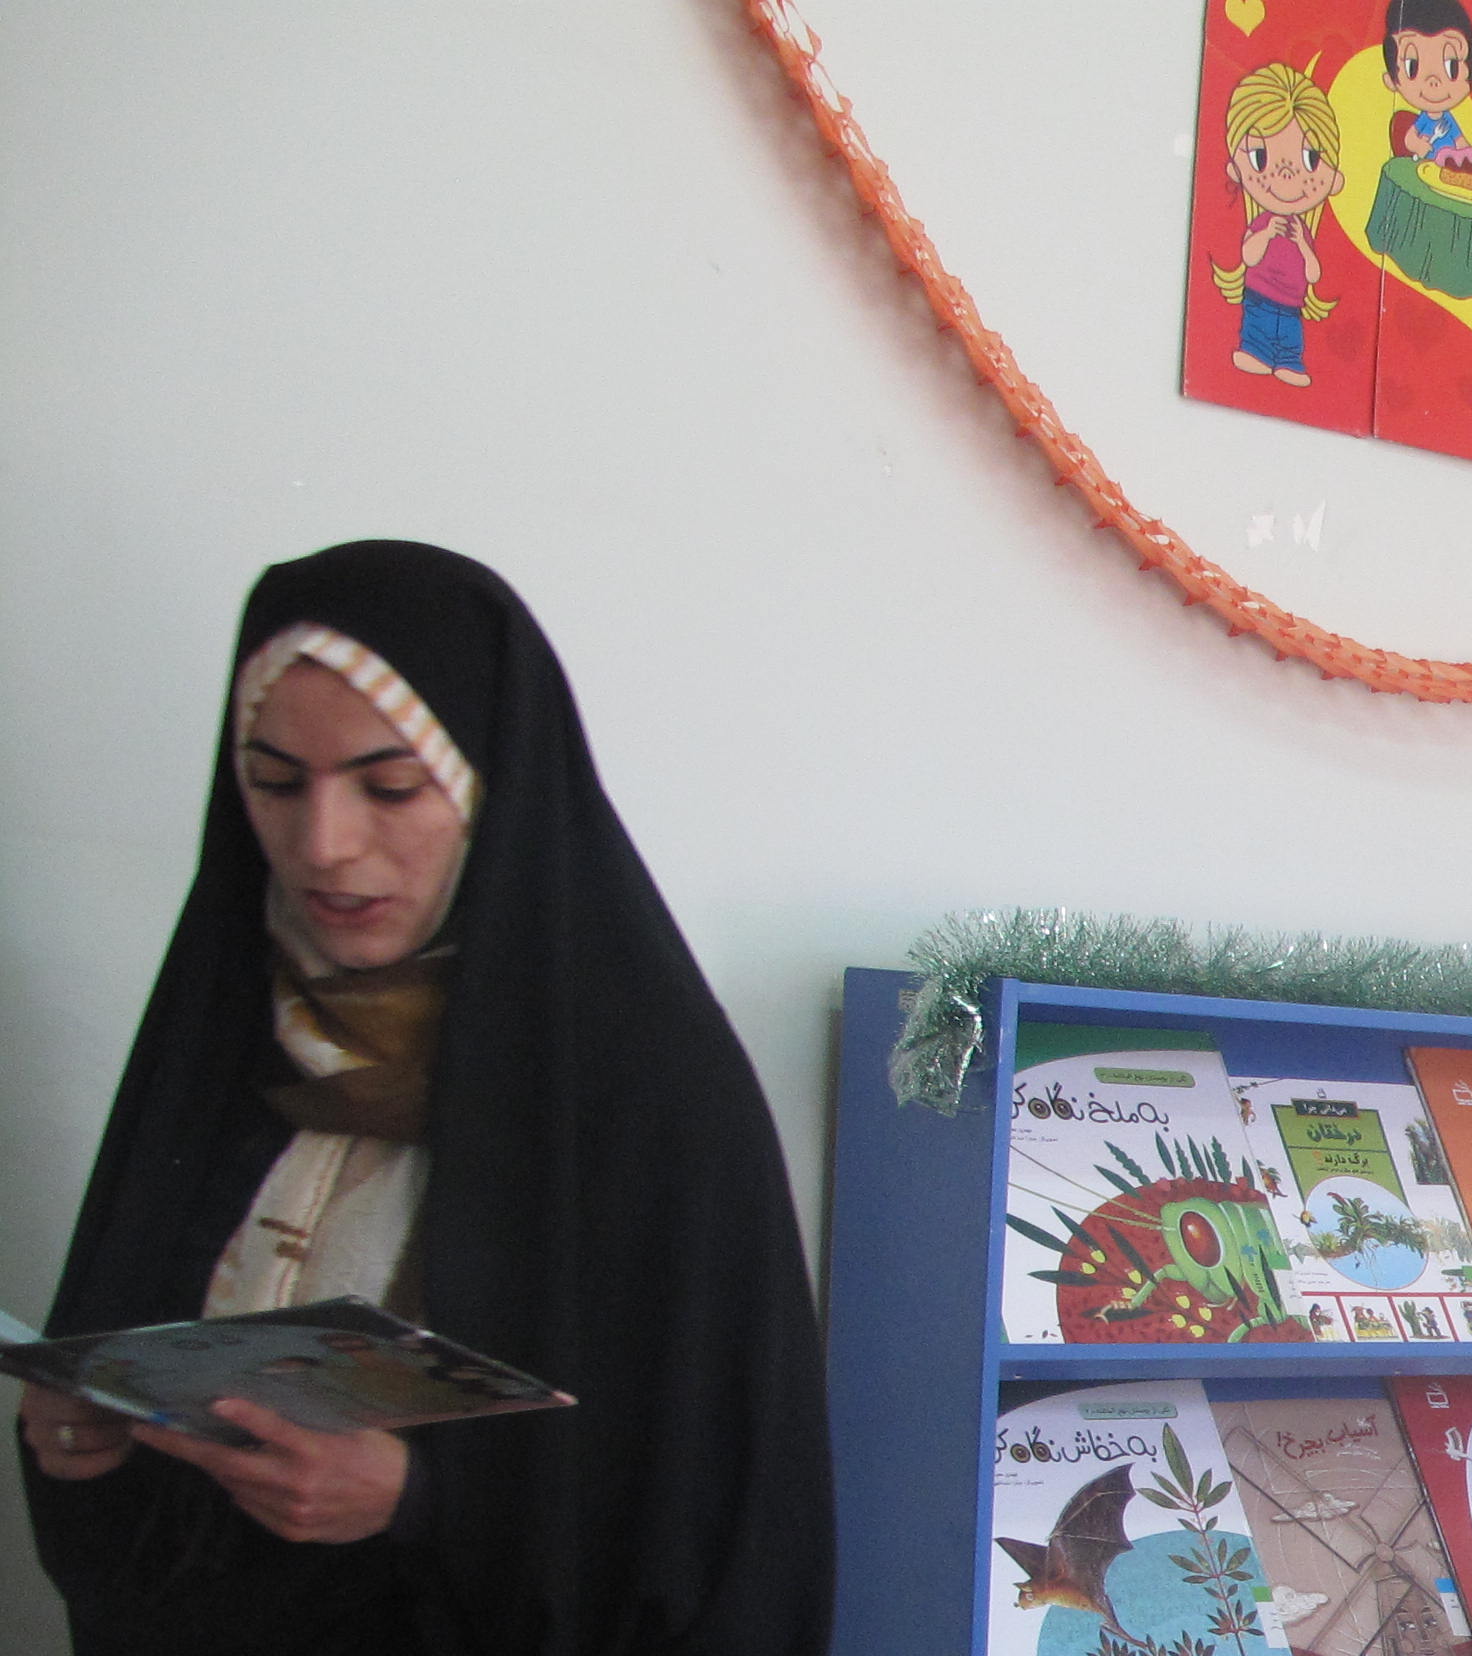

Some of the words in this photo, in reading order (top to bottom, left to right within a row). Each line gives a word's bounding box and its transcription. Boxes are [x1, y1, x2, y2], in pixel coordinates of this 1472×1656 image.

[1028, 1081, 1085, 1120] نگاه
[1089, 1092, 1139, 1124] ملخ
[1138, 1102, 1169, 1132] به
[1307, 1122, 1362, 1145] درختان
[1010, 1425, 1061, 1463] نگاه
[1328, 1413, 1380, 1447] آسیاب
[1063, 1430, 1130, 1463] خفاش
[1127, 1435, 1158, 1463] به
